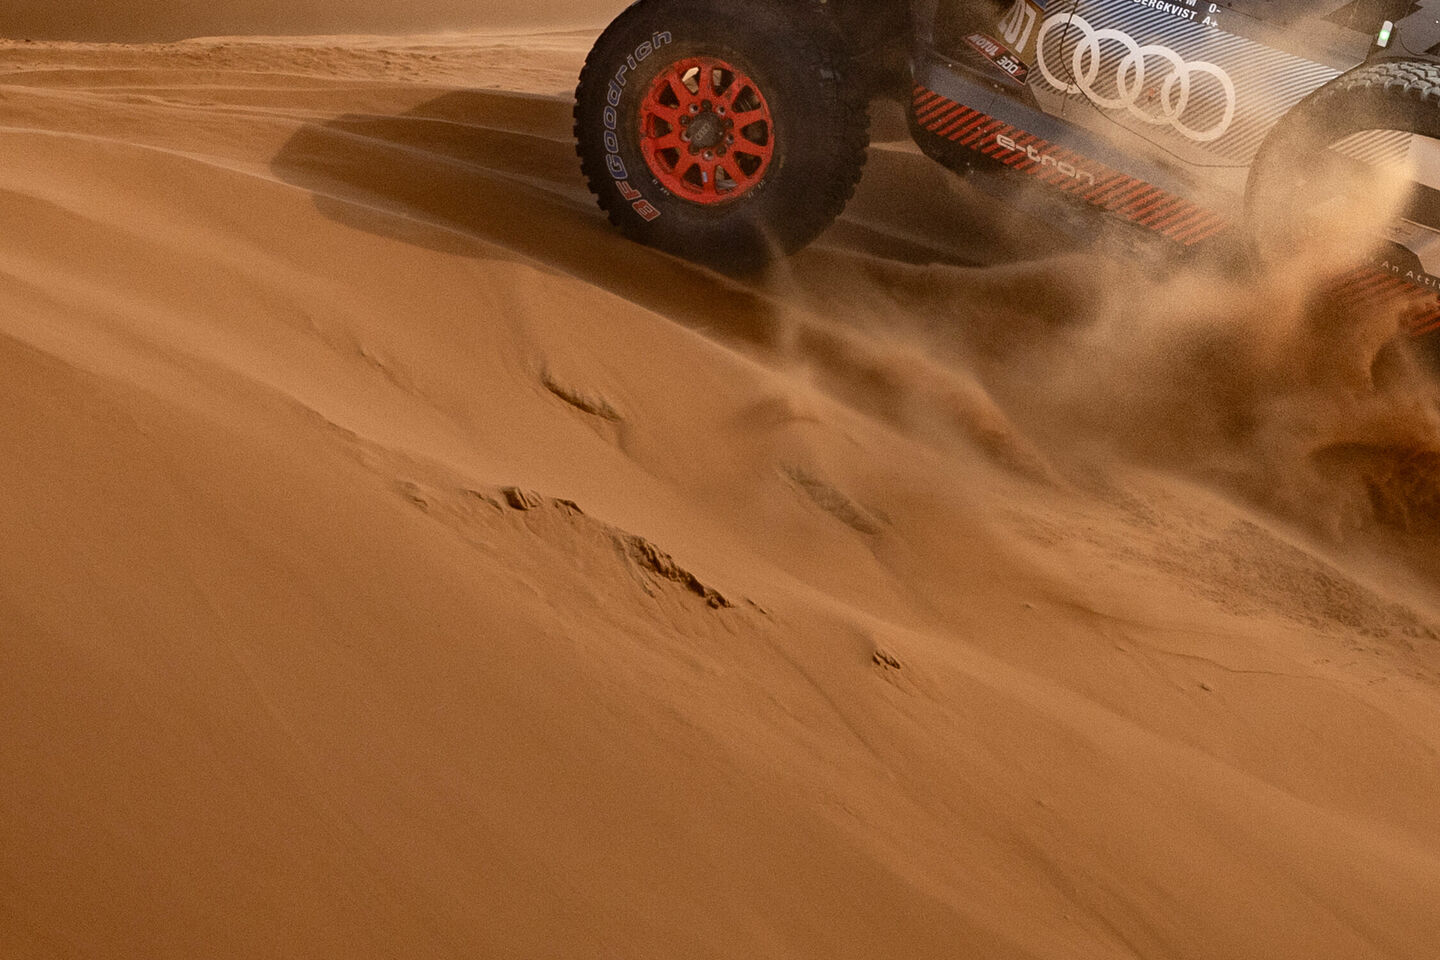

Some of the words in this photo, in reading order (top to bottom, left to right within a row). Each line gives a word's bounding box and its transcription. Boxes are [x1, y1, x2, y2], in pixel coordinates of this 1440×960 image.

[1202, 16, 1219, 27] A+
[967, 34, 999, 56] MOTUL
[603, 30, 672, 222] BFGoodrich
[997, 134, 1095, 185] e-tron
[1382, 260, 1399, 273] An
